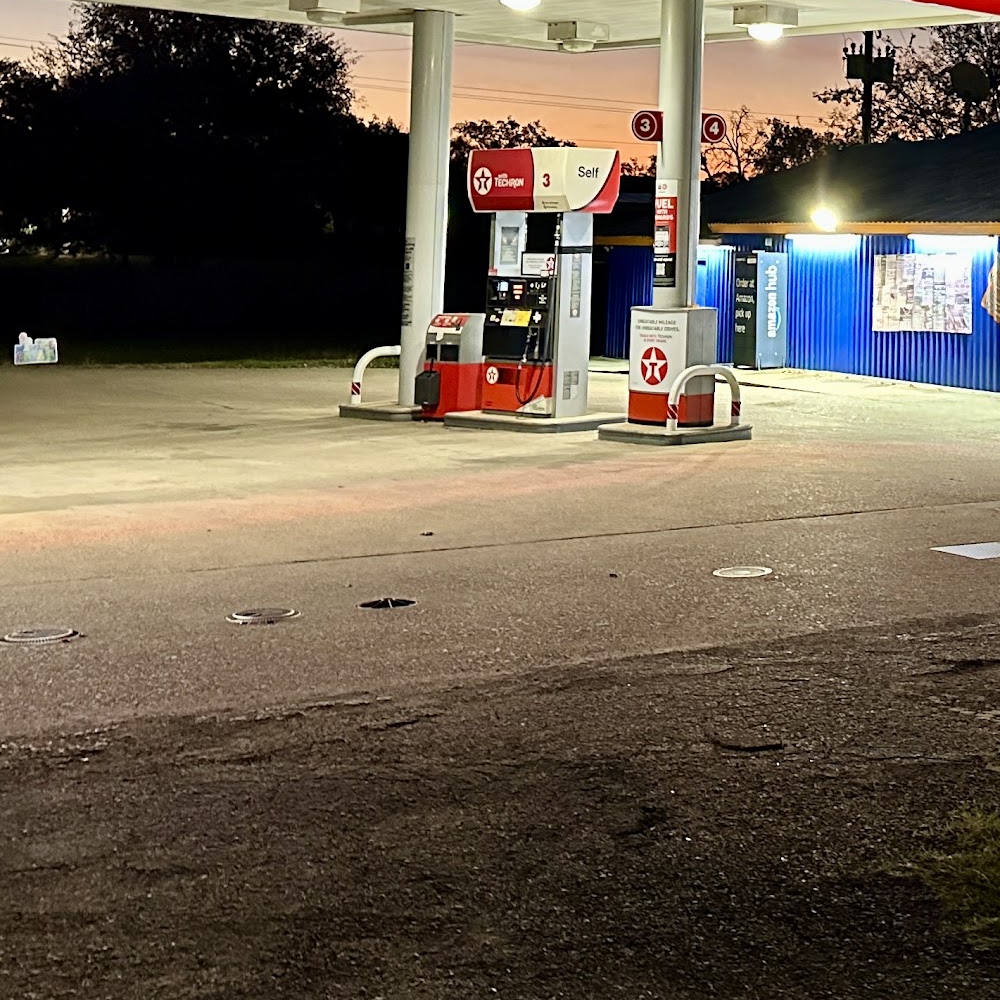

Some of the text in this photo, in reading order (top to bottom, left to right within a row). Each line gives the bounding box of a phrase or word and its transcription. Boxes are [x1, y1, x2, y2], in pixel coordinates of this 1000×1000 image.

[640, 118, 650, 132] 3
[709, 121, 720, 135] 4
[578, 166, 599, 178] Self
[494, 177, 524, 188] TECHRON
[542, 173, 551, 187] 3
[765, 264, 778, 338] amazon hub
[735, 323, 746, 334] here
